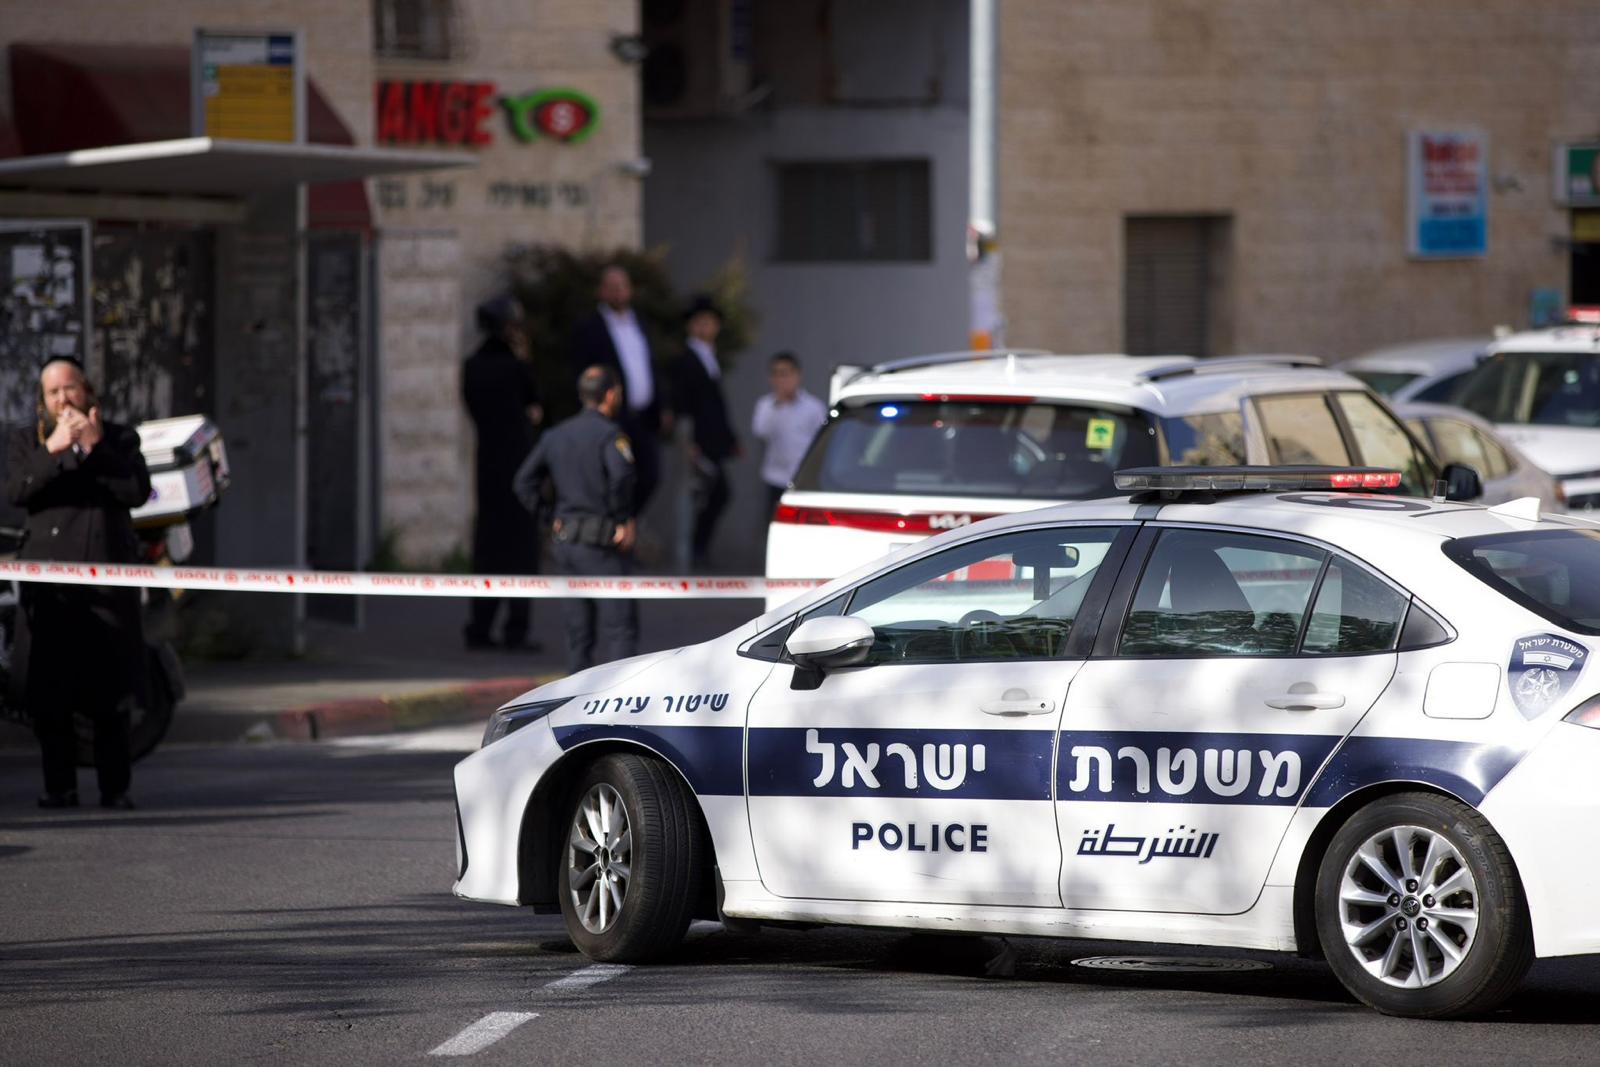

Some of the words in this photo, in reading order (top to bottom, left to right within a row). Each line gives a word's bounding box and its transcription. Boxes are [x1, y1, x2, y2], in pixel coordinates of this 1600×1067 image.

[1518, 638, 1551, 650] ישראל
[1551, 638, 1584, 658] משטרת
[583, 696, 650, 715] עירוני
[663, 693, 729, 713] שיטור
[805, 728, 986, 790] ישראל
[1069, 745, 1302, 798] משטרת
[852, 822, 988, 853] POLICE
[1076, 823, 1220, 865] الشرطة
